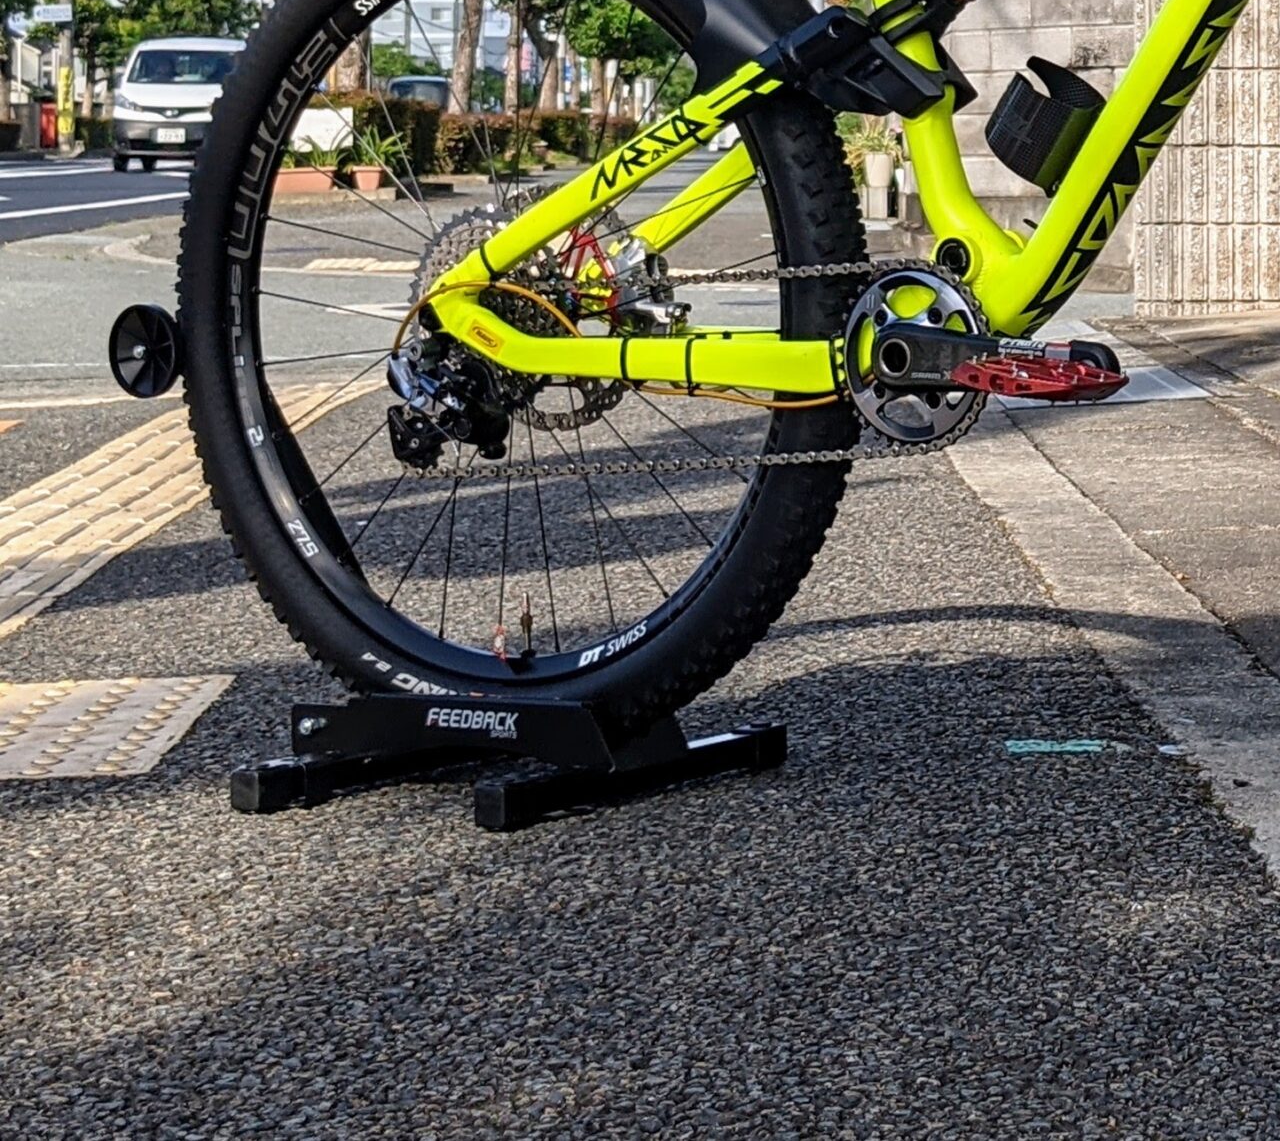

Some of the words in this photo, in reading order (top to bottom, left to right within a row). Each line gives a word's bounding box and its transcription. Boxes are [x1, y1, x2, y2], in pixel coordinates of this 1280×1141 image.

[590, 114, 710, 202] META
[288, 519, 319, 558] 27.5
[578, 645, 605, 668] DT
[605, 619, 648, 657] SWISS
[425, 707, 520, 733] FEEDBACK
